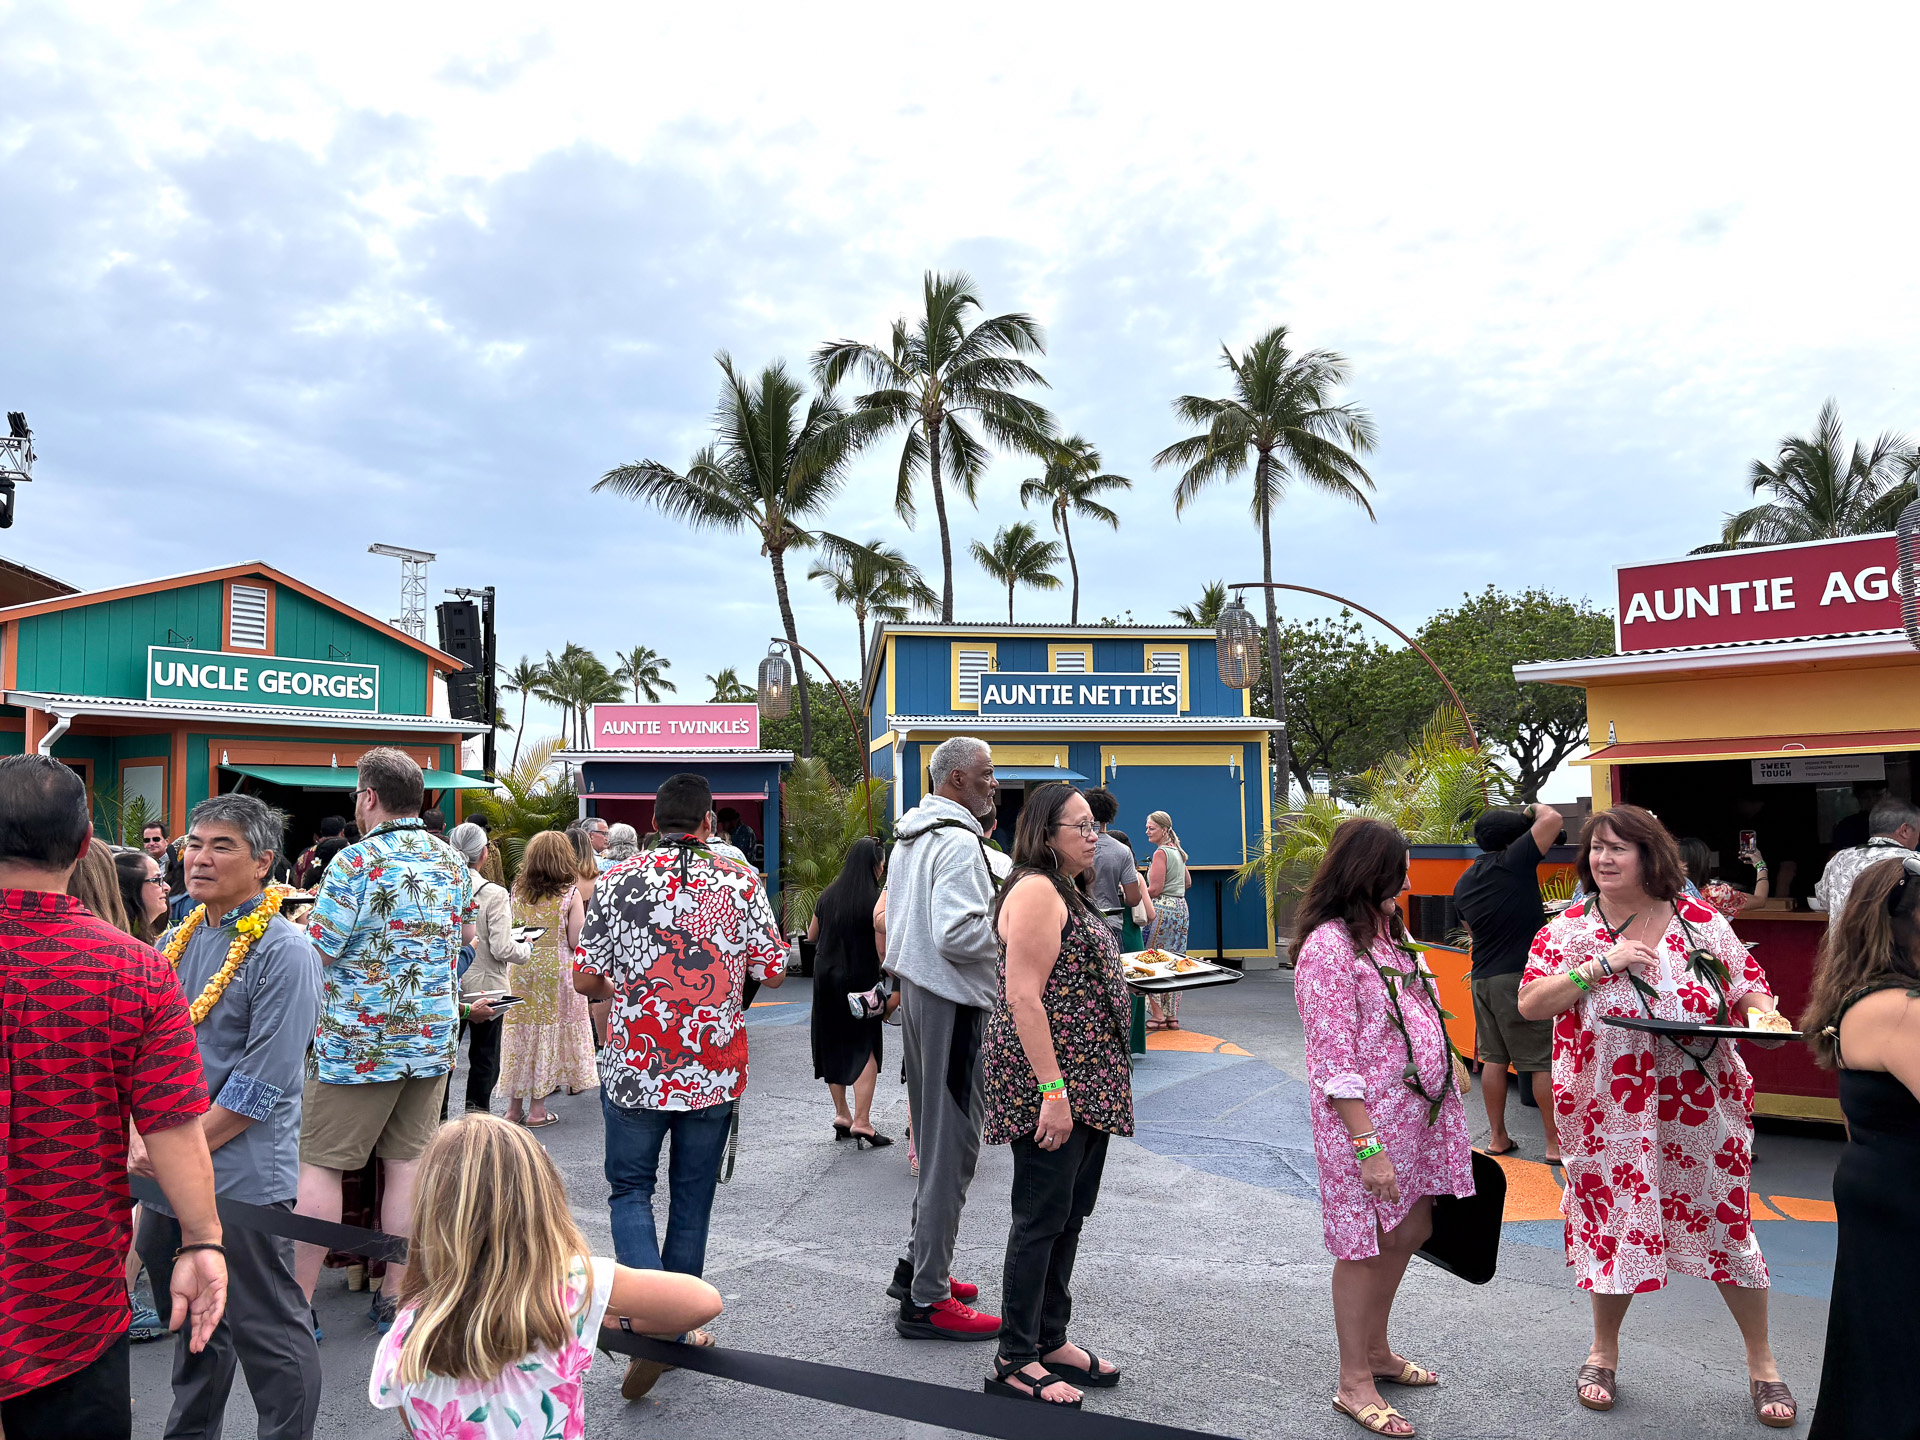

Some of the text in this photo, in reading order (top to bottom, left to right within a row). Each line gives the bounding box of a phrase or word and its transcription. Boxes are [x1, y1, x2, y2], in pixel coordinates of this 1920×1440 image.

[1623, 576, 1796, 625] AUNTIE
[154, 661, 374, 700] UNCLE GEORGE'S
[983, 681, 1177, 706] AUNTIE NETTIE'S
[601, 717, 750, 735] AUNTIE TWINKLE'S
[1760, 762, 1791, 770] SWEET
[1760, 769, 1792, 778] TOUCH
